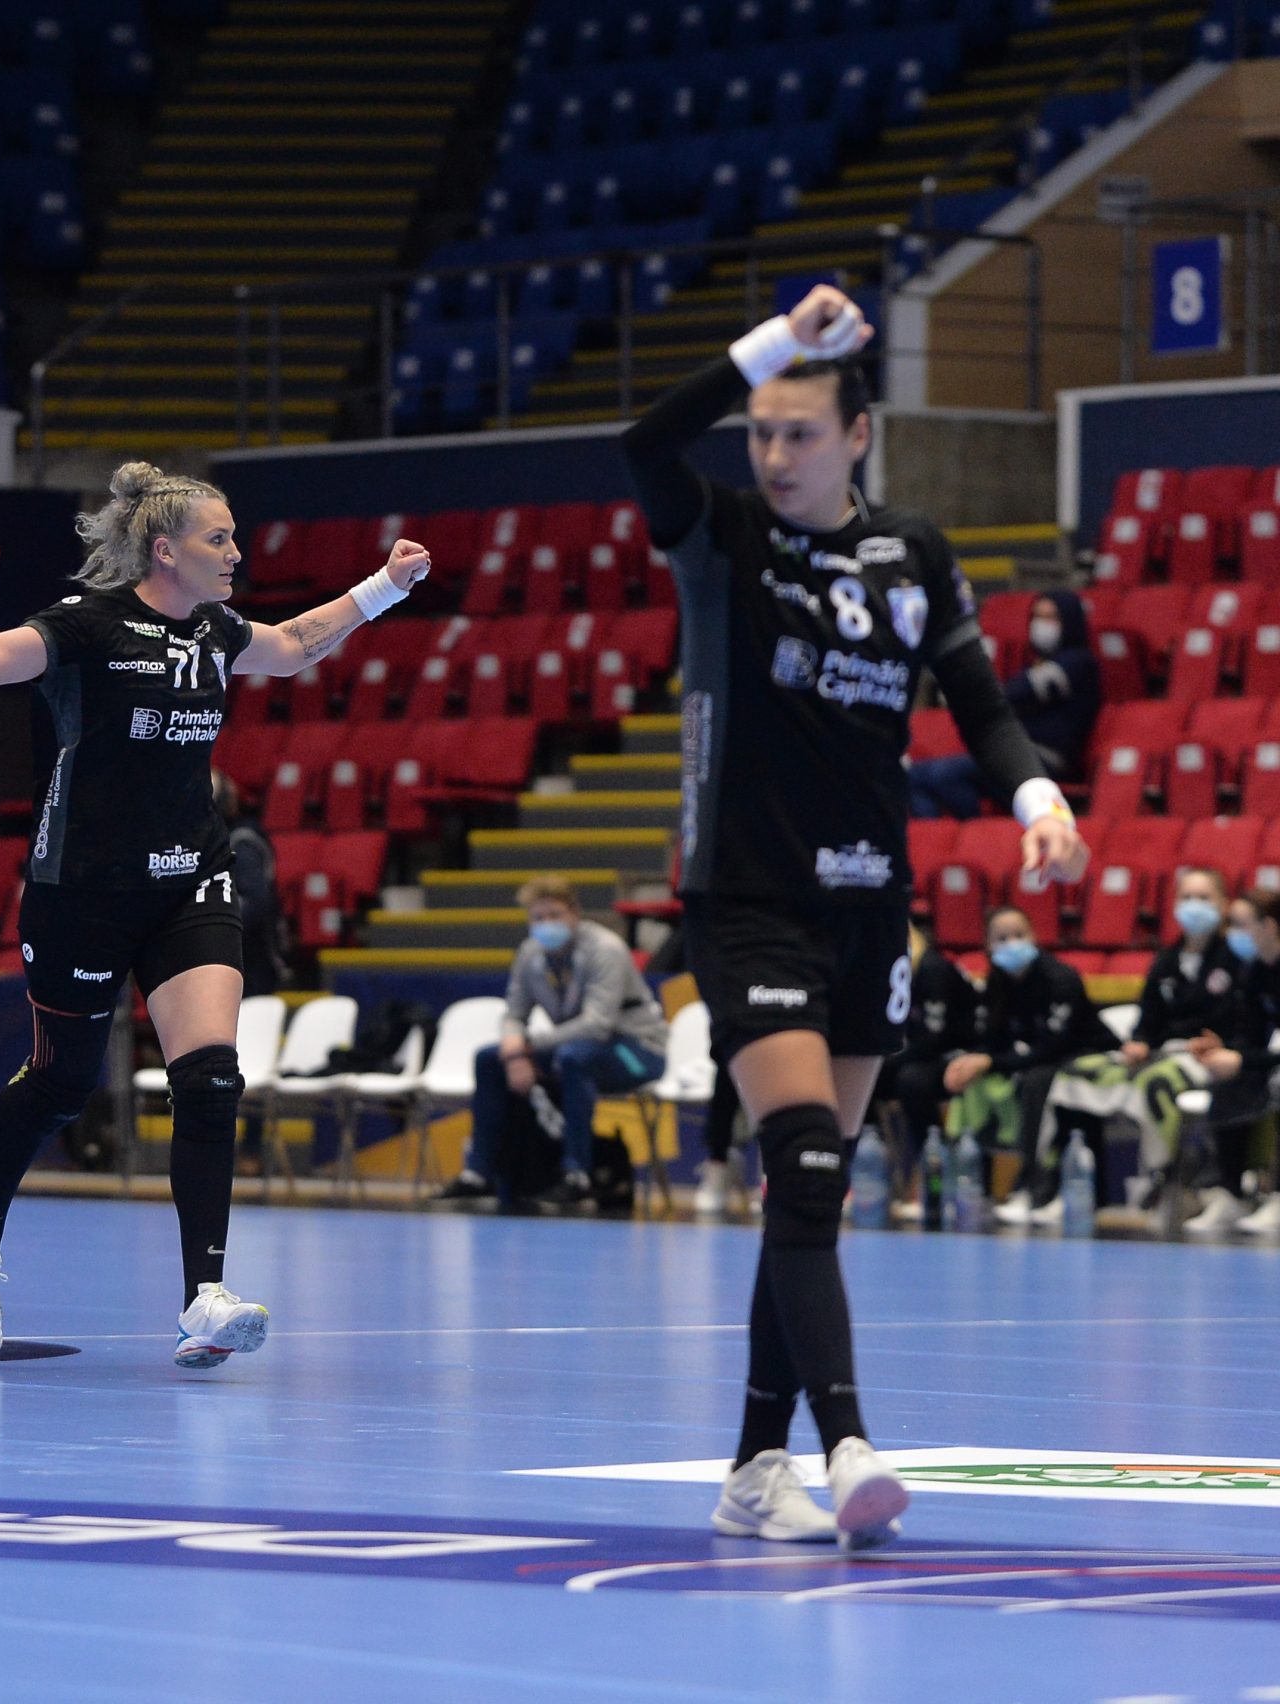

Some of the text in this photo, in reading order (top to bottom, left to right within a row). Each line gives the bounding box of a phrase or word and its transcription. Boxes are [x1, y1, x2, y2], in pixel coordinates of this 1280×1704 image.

[1170, 265, 1205, 326] 8
[828, 575, 873, 641] 8
[108, 660, 166, 671] cocomax
[167, 644, 200, 689] 71
[169, 709, 222, 726] Primăria
[148, 851, 201, 870] BORSEC
[73, 967, 113, 983] Kempa
[748, 984, 808, 1008] Kempa
[886, 955, 912, 1025] 8
